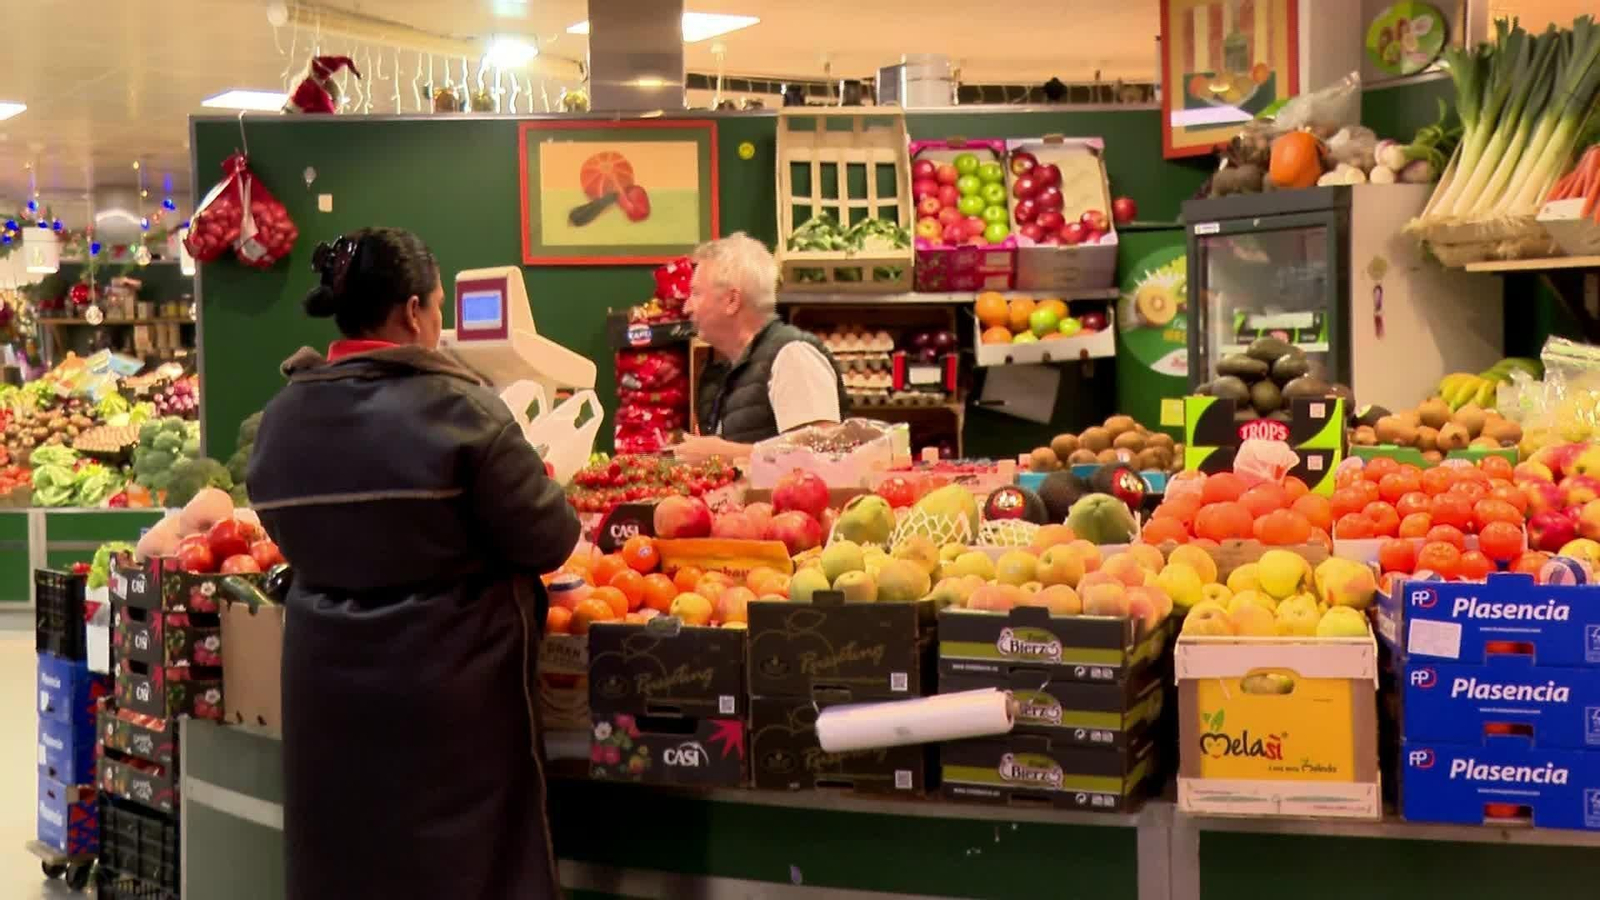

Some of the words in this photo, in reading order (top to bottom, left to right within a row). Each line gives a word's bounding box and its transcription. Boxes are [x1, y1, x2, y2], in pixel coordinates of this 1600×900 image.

[1240, 424, 1288, 441] TROPS
[1452, 597, 1570, 621] Plasencia
[1451, 677, 1570, 703] Plasencia
[663, 749, 699, 767] CASI
[1450, 758, 1569, 784] Plasencia
